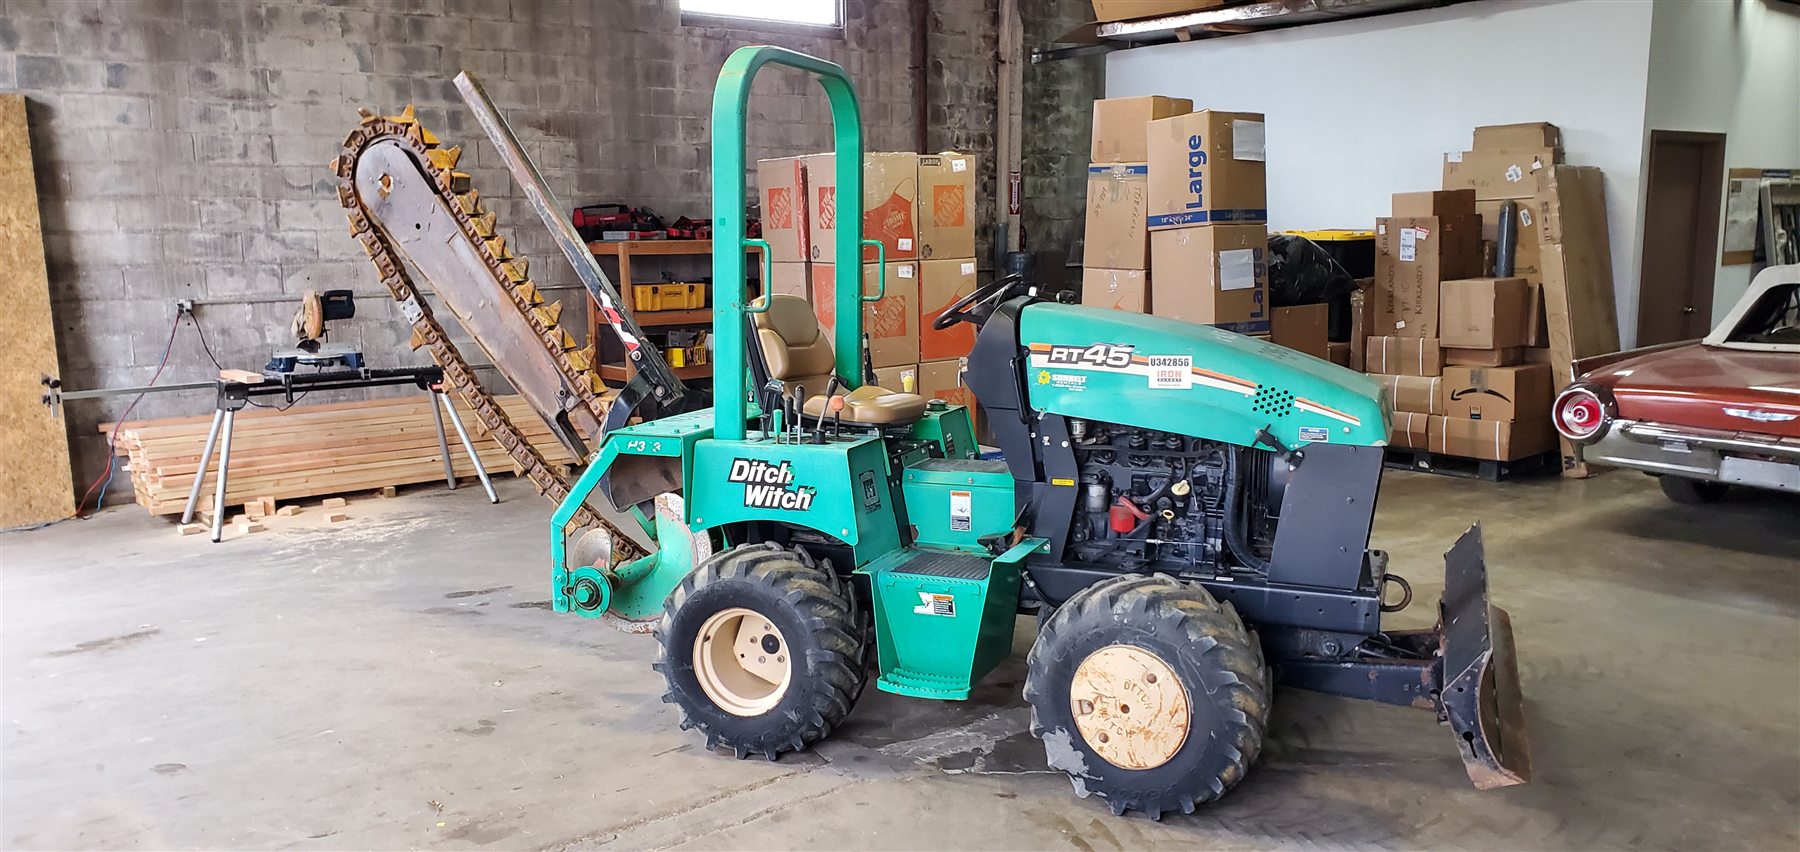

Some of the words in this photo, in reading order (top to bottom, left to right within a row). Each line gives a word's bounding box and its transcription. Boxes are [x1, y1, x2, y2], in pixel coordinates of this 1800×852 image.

[1186, 134, 1207, 209] Large
[1250, 247, 1267, 319] Large
[1415, 264, 1423, 315] KIRKLAND'S
[1050, 344, 1134, 368] RT45
[1150, 358, 1190, 367] U342856
[1157, 370, 1182, 378] IRON
[730, 460, 793, 484] Ditch
[746, 485, 812, 510] Witch
